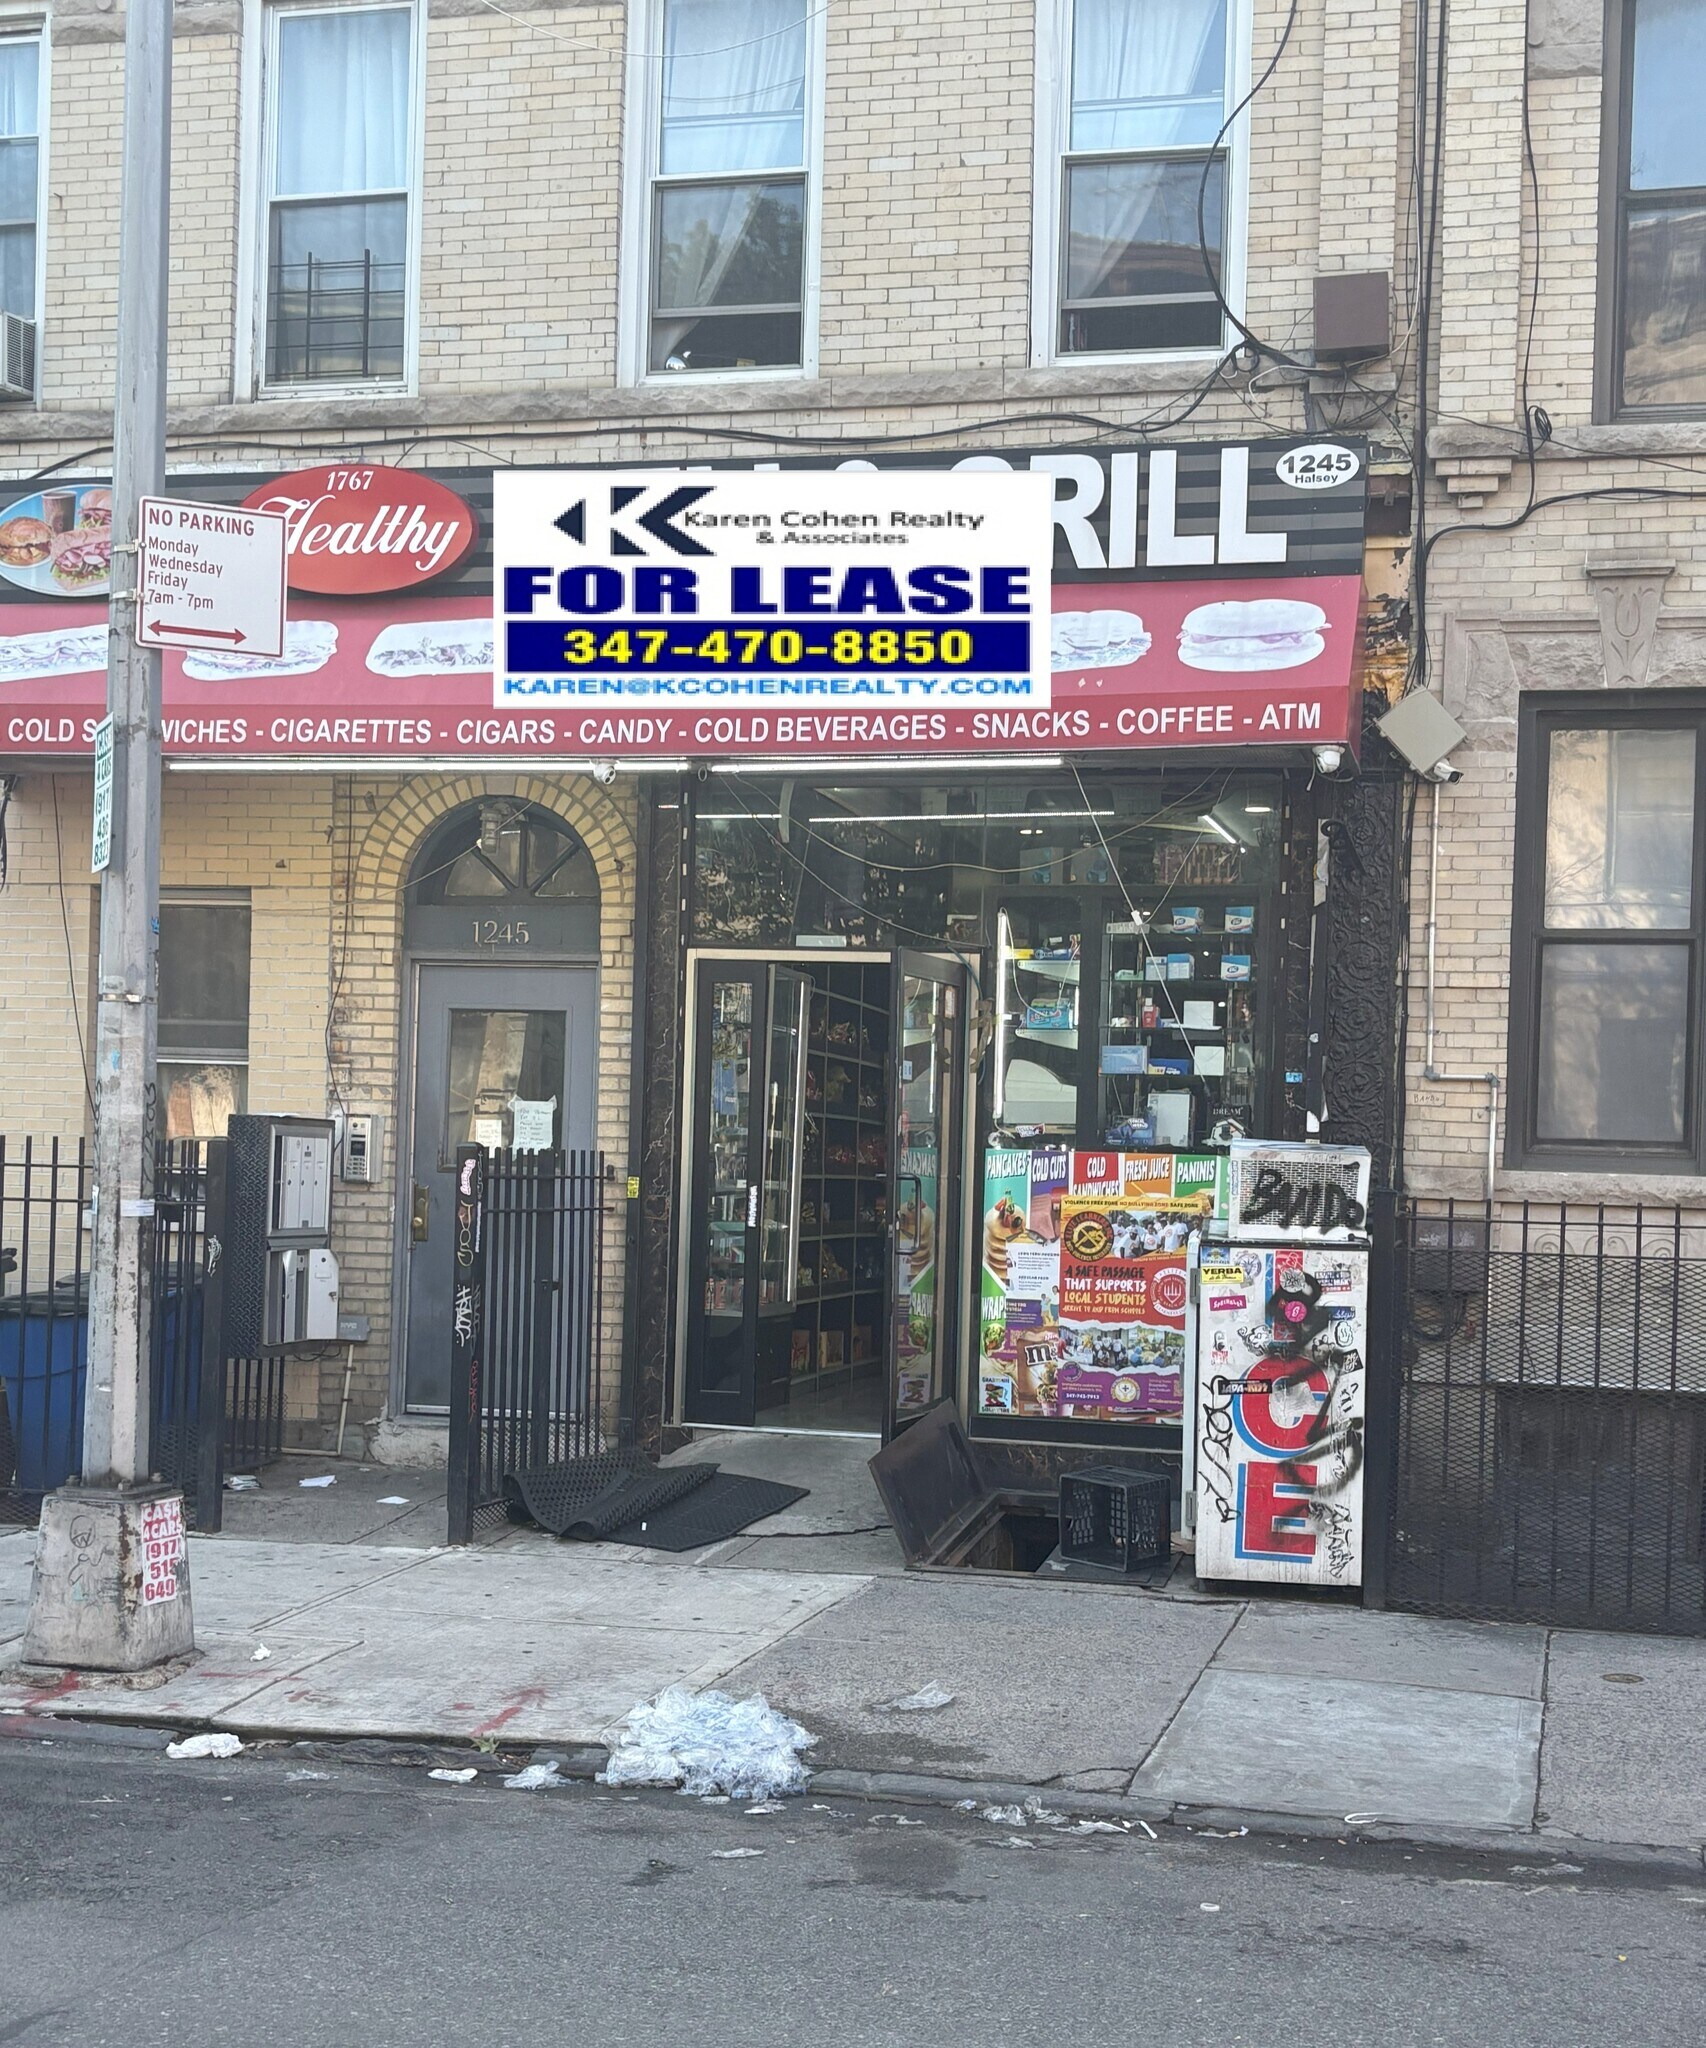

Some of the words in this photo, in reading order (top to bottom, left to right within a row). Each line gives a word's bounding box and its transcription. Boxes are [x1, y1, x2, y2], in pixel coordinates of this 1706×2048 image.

[1281, 453, 1352, 474] 1245
[326, 471, 374, 491] 1767
[1294, 473, 1339, 486] Halsey
[948, 447, 1287, 570] RILL
[148, 507, 174, 527] NO
[179, 512, 255, 537] PARKING
[257, 494, 460, 572] Healthy
[148, 538, 199, 557] Monday
[148, 554, 223, 578] Wednesday
[147, 572, 188, 590] Friday
[147, 590, 174, 606] 7am
[187, 594, 214, 610] 7pm
[8, 718, 75, 742] COLD
[82, 718, 248, 743] SWICHES
[270, 718, 432, 744] CIGARETTES
[456, 718, 555, 744] CIGARS
[579, 718, 673, 743] CANDY
[694, 717, 769, 743] COLD
[776, 715, 946, 742] BEVERAGES
[972, 709, 1090, 740] SNACKS
[1117, 704, 1233, 735] COFFEE
[1259, 703, 1321, 731] ATM
[472, 920, 530, 945] 1245
[1033, 1157, 1048, 1182] COLD
[1050, 1155, 1066, 1180] CUTS
[1087, 1157, 1106, 1178] COLD
[1126, 1160, 1148, 1182] FRESH
[1149, 1157, 1170, 1180] JUICE
[1177, 1160, 1215, 1184] PANINIS
[1064, 1265, 1073, 1278] A
[1075, 1265, 1099, 1278] SAFE
[1101, 1266, 1145, 1279] PASSAGE
[1064, 1278, 1092, 1291] THAT
[1095, 1279, 1147, 1293] SUPPORTS
[1064, 1291, 1092, 1304] LOCAL
[1095, 1292, 1147, 1306] STUDENTS
[1062, 1305, 1082, 1314] ARRIVE
[1104, 1306, 1120, 1314] FROM
[144, 1501, 180, 1521] CASH
